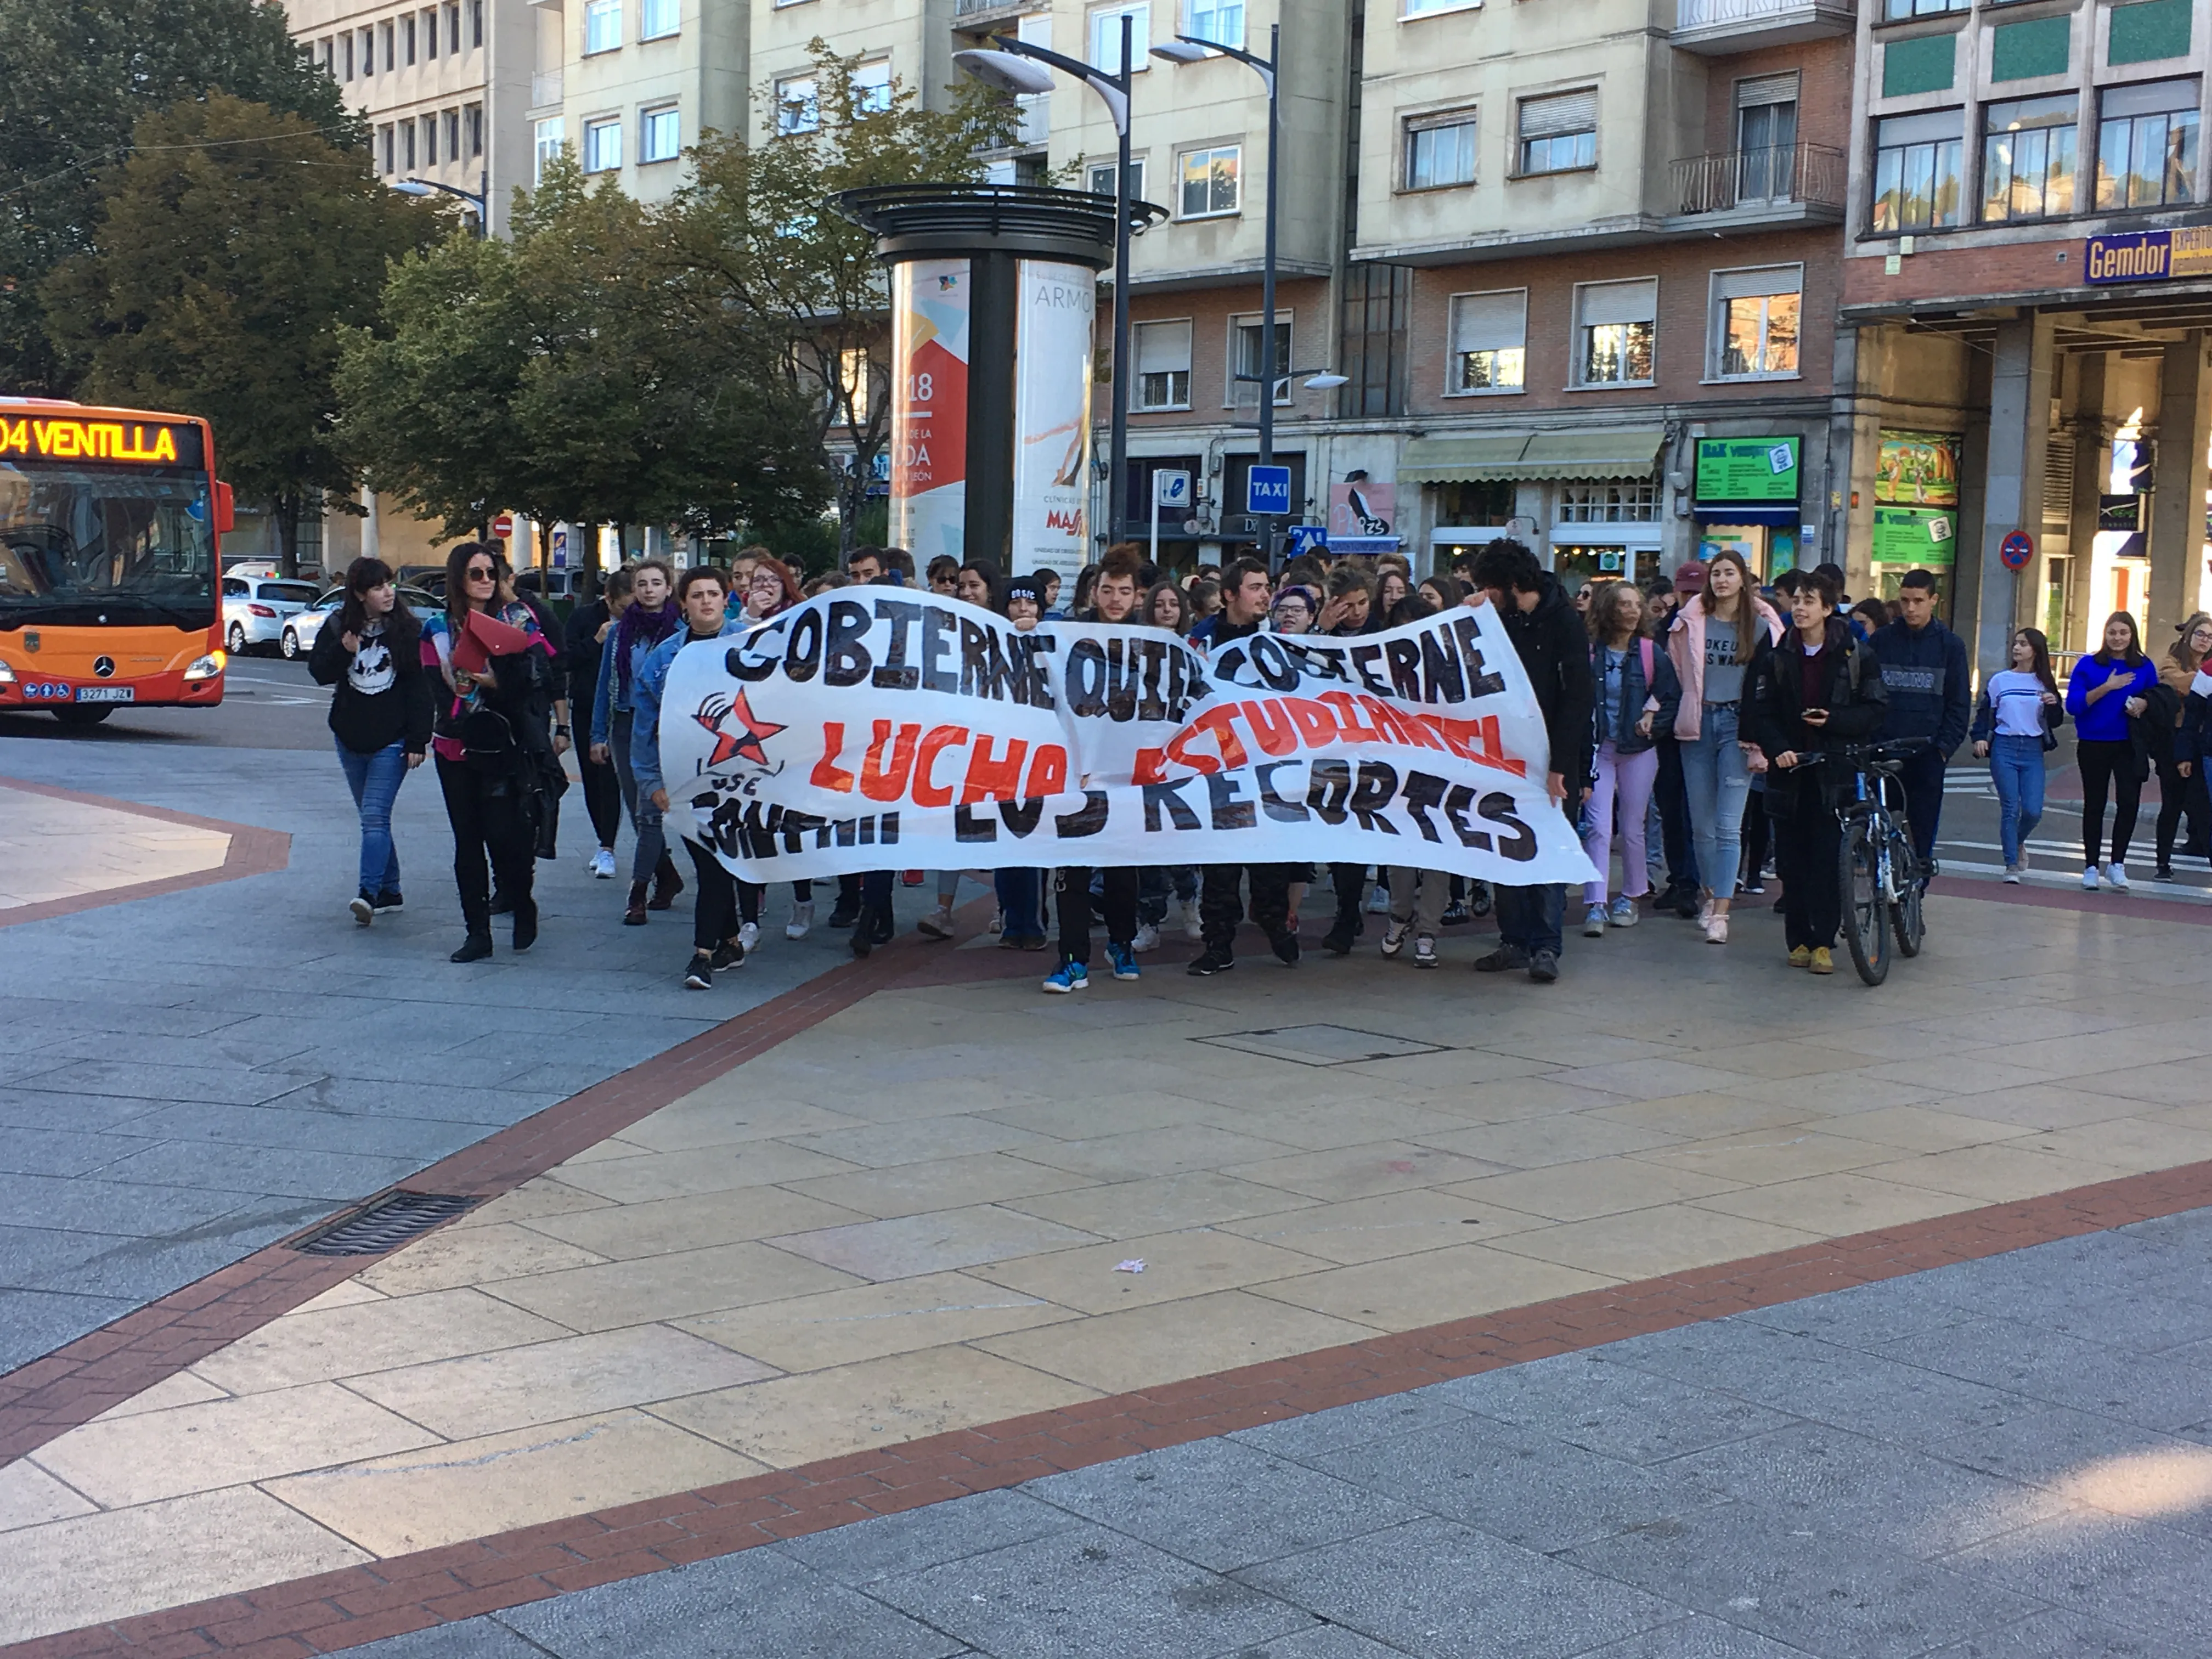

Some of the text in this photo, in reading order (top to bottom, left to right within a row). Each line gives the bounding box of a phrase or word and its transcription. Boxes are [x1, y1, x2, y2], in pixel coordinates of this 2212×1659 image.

[2089, 238, 2169, 279] Gemdor
[32, 420, 176, 461] VENTILLA
[921, 428, 932, 439] LA
[1252, 482, 1287, 496] TAXI
[1706, 639, 1729, 651] OKE
[725, 599, 1056, 710] GOBIERNE
[1718, 654, 1739, 667] WA
[82, 689, 109, 699] 3271
[810, 719, 1067, 808] LUCHA
